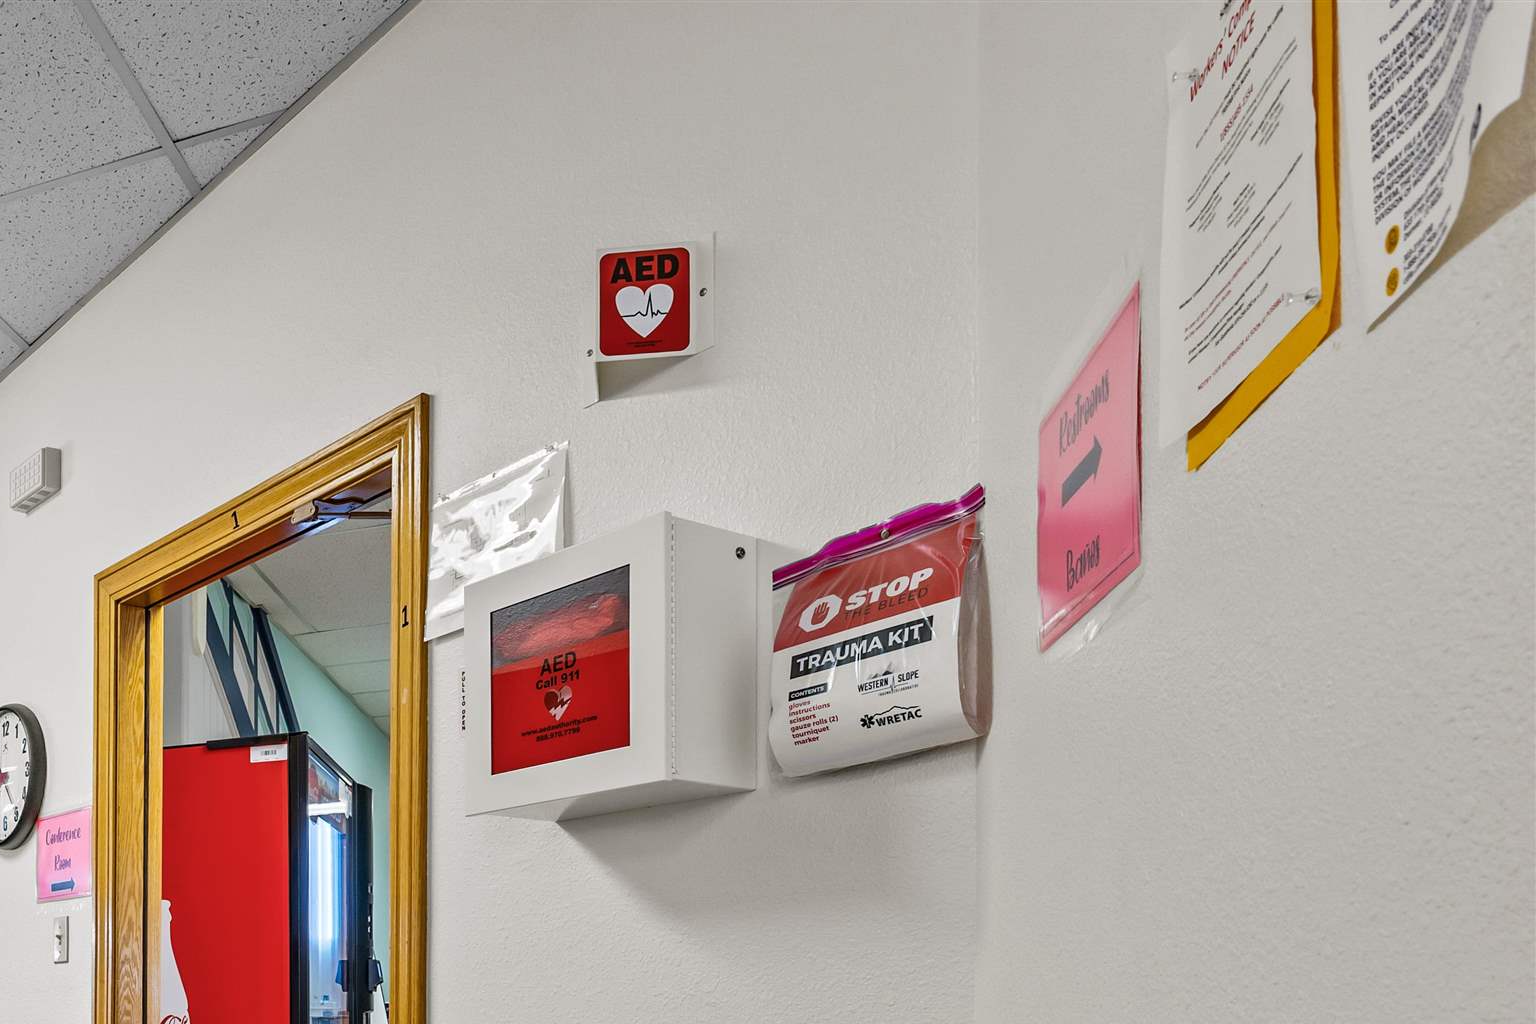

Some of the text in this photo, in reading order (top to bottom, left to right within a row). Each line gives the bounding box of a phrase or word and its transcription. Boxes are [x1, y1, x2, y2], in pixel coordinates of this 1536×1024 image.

[1222, 11, 1255, 80] NOTICE
[1375, 53, 1390, 71] YOU
[1378, 62, 1393, 80] YOU
[1369, 81, 1395, 111] REPORT
[1396, 61, 1414, 83] YOUR
[1370, 105, 1394, 131] ADVISE
[1395, 84, 1413, 106] YOUR
[1370, 115, 1396, 142] OBTAIN
[1371, 135, 1385, 151] AND
[1373, 166, 1386, 182] YOU
[1388, 152, 1402, 169] MAY
[610, 254, 680, 284] AED
[231, 510, 240, 530] 1
[845, 567, 934, 611] STOP
[844, 587, 929, 620] THE BLEED
[401, 605, 409, 628] 1
[796, 623, 923, 672] TRAUMA KIT
[540, 651, 577, 676] AED
[536, 670, 580, 690] Call 911
[858, 670, 919, 693] WESTERN SLOPE
[790, 686, 825, 700] CONTENTS
[789, 700, 810, 710] gloves
[789, 702, 830, 717] instructions
[789, 714, 816, 724] scissors
[790, 715, 839, 732] gauze rolls (2)
[875, 709, 922, 727] WRETAC
[2, 720, 10, 738] 12
[14, 723, 19, 739] 1
[792, 725, 829, 739] tourniquet
[21, 738, 27, 754] 2
[794, 735, 819, 746] marker
[3, 815, 8, 832] 6
[45, 826, 81, 846] Conference
[54, 854, 72, 871] Room
